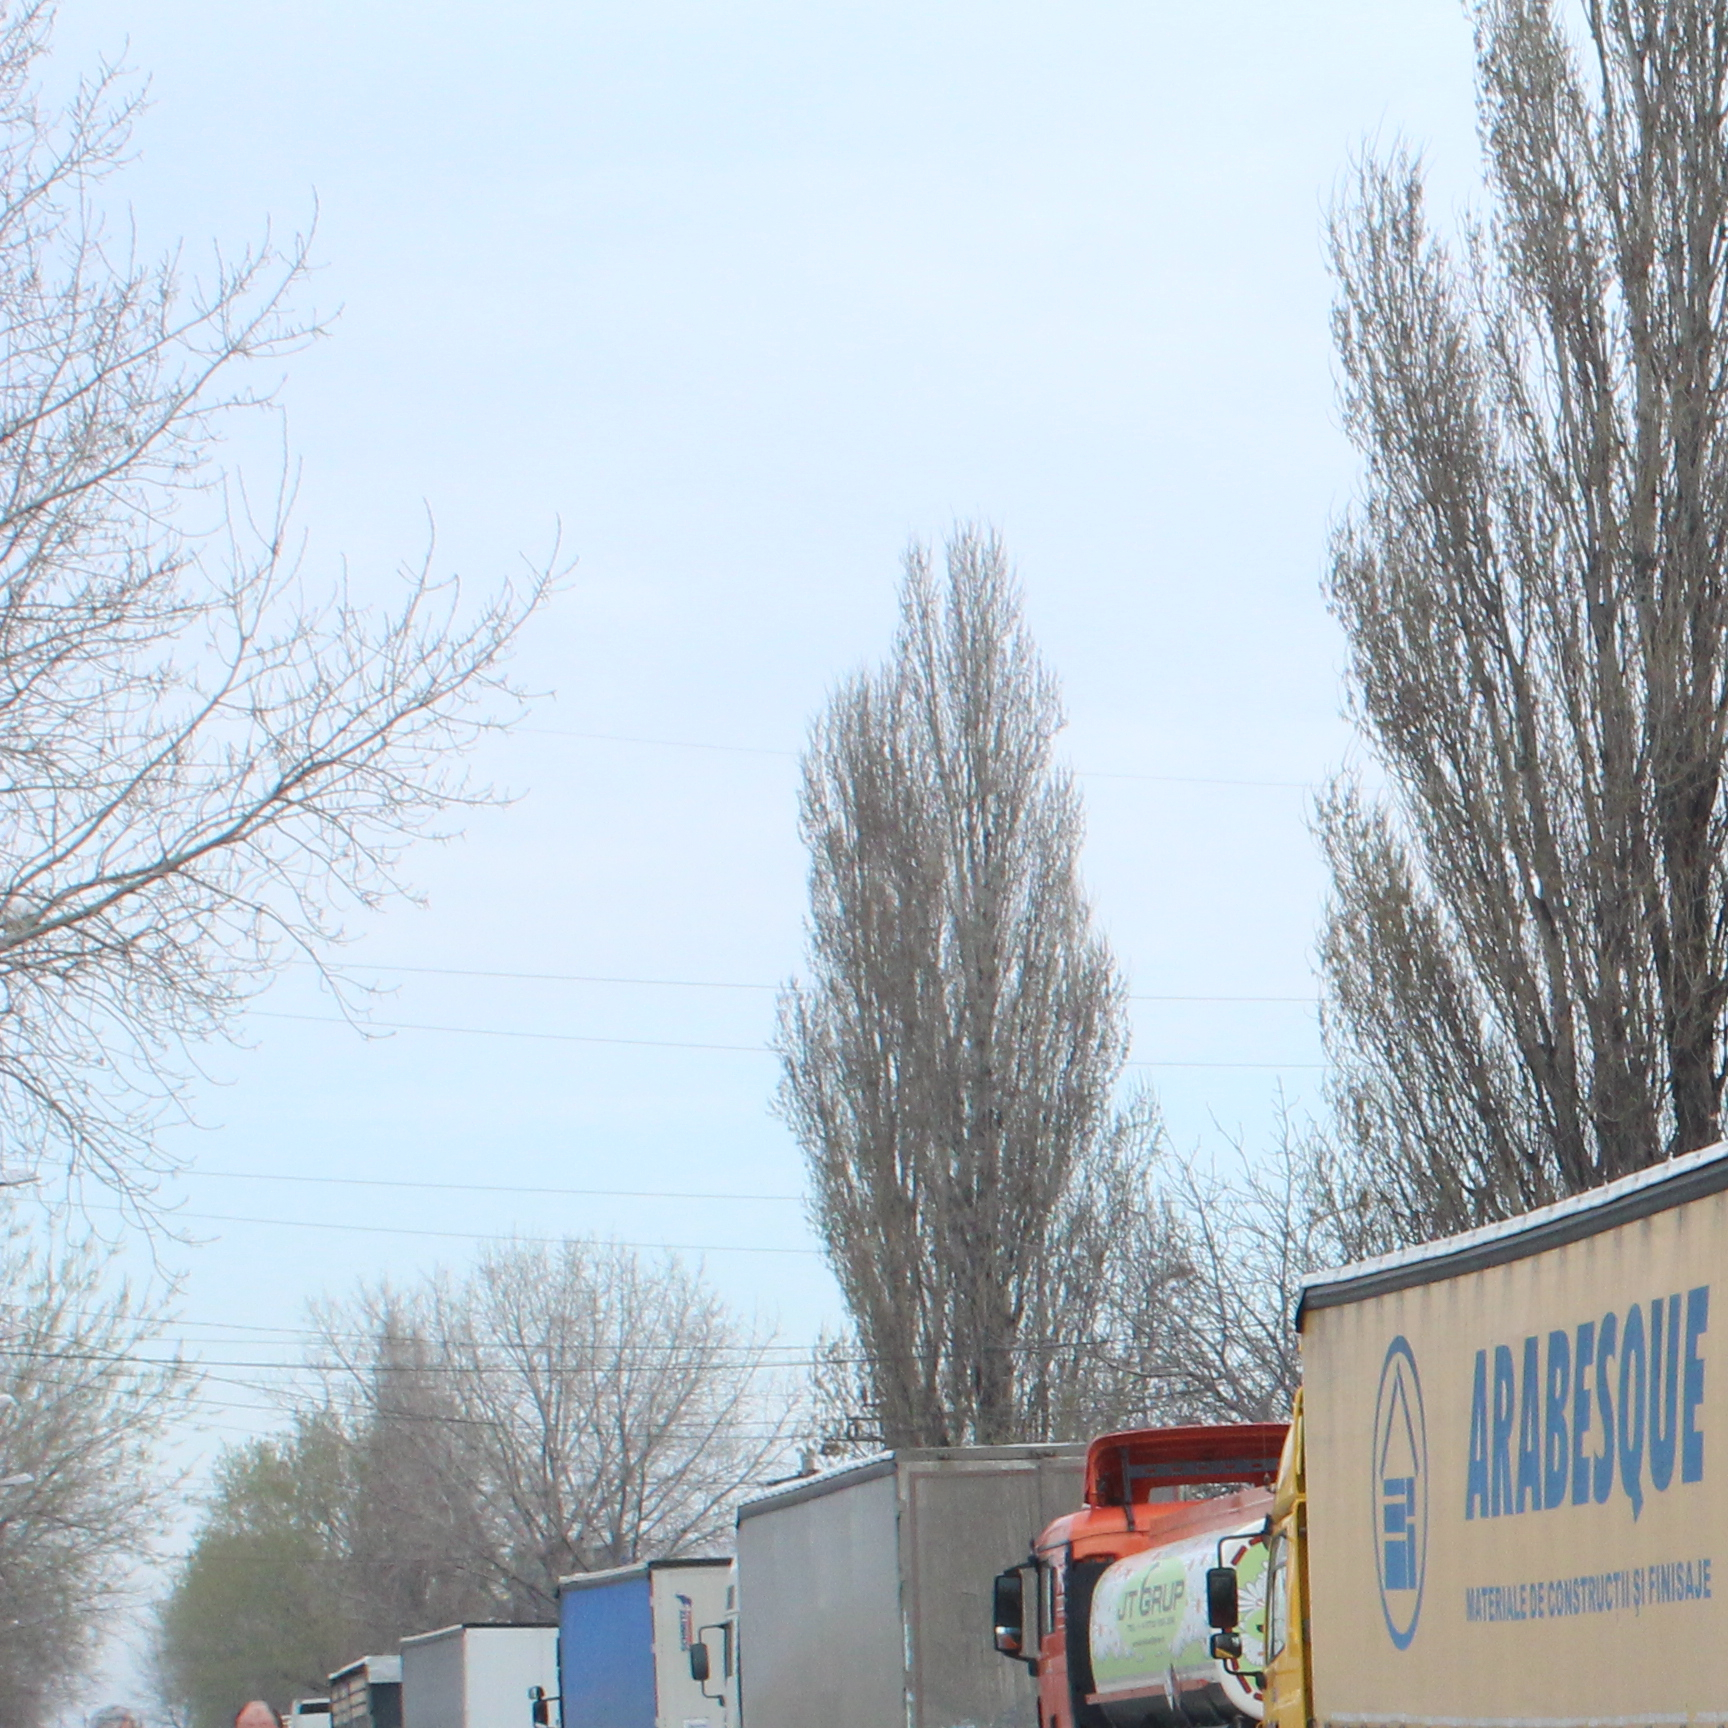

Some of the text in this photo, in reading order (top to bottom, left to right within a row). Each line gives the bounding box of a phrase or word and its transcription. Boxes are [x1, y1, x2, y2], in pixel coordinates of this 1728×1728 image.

[1465, 1285, 1710, 1523] ARABESQUE
[1118, 1590, 1138, 1620] JT
[1466, 1585, 1527, 1622] MATERIALE
[1530, 1581, 1545, 1620] DE
[1649, 1558, 1712, 1605] FINISAJE
